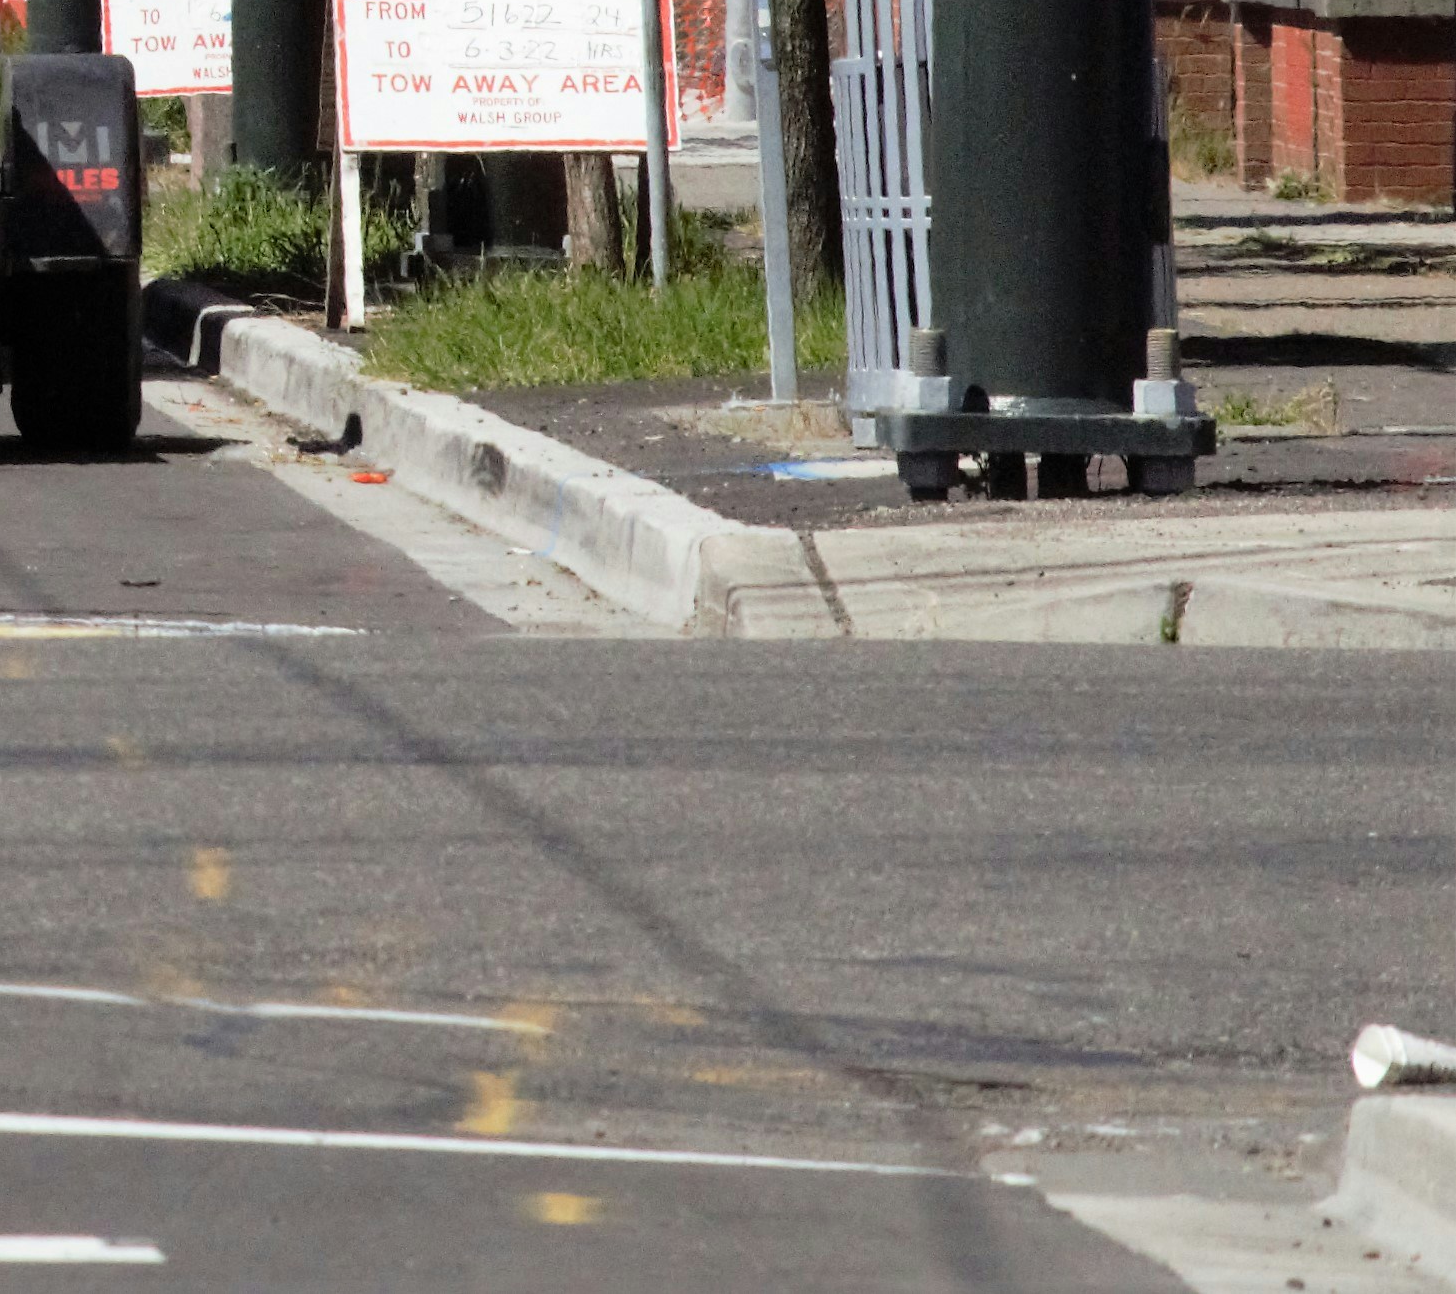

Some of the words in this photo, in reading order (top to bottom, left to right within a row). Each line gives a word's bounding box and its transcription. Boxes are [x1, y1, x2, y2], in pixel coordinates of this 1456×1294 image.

[140, 9, 161, 25] TO
[366, 2, 426, 20] FROM
[131, 36, 177, 53] TOW
[193, 33, 231, 51] AW
[386, 41, 411, 58] TO
[372, 73, 432, 93] TOW
[452, 73, 539, 93] AWAY
[560, 74, 643, 93] AREA
[472, 97, 524, 107] PROPERTY
[457, 112, 507, 124] WALSH
[513, 112, 563, 124] GROUP
